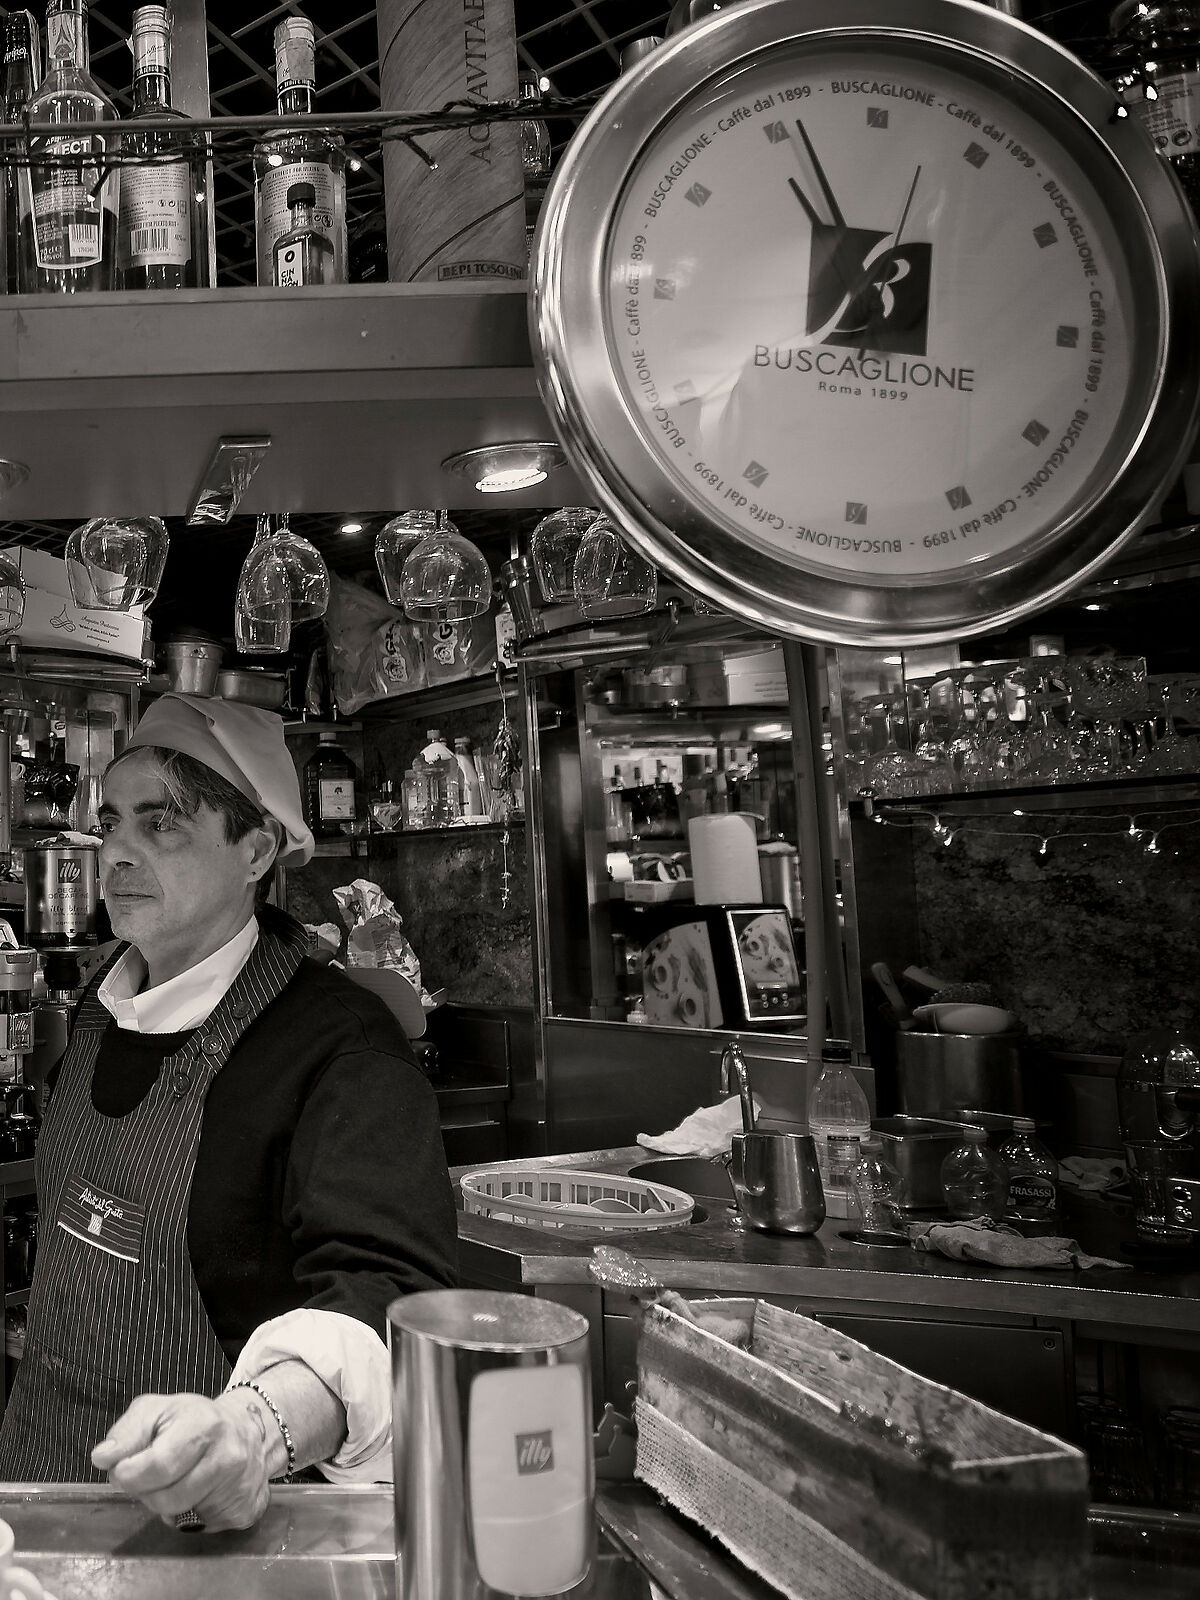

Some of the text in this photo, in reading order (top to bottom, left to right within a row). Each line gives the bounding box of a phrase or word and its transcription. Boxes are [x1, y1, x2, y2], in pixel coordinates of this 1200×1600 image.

[831, 81, 1036, 168] BUSCAGLIONE Caffè dal 1899
[644, 85, 812, 218] BUSCAGLIONE Caffè dal 1899
[281, 268, 295, 279] CIN
[282, 275, 296, 284] NA
[443, 263, 522, 280] BEPI TOSOLINI
[1042, 180, 1106, 392] BUSCAGLIONE Caffè dal 1899
[753, 344, 975, 392] BUSCAGLIONE
[818, 381, 908, 401] Roma 1899
[923, 409, 1089, 548] BUSCAGLIONE Caffè dal 1899
[694, 461, 902, 553] BUSCAGLIONE Caffè dal 1899
[59, 862, 81, 882] illy
[14, 1019, 30, 1031] illy
[520, 1439, 551, 1471] illy
